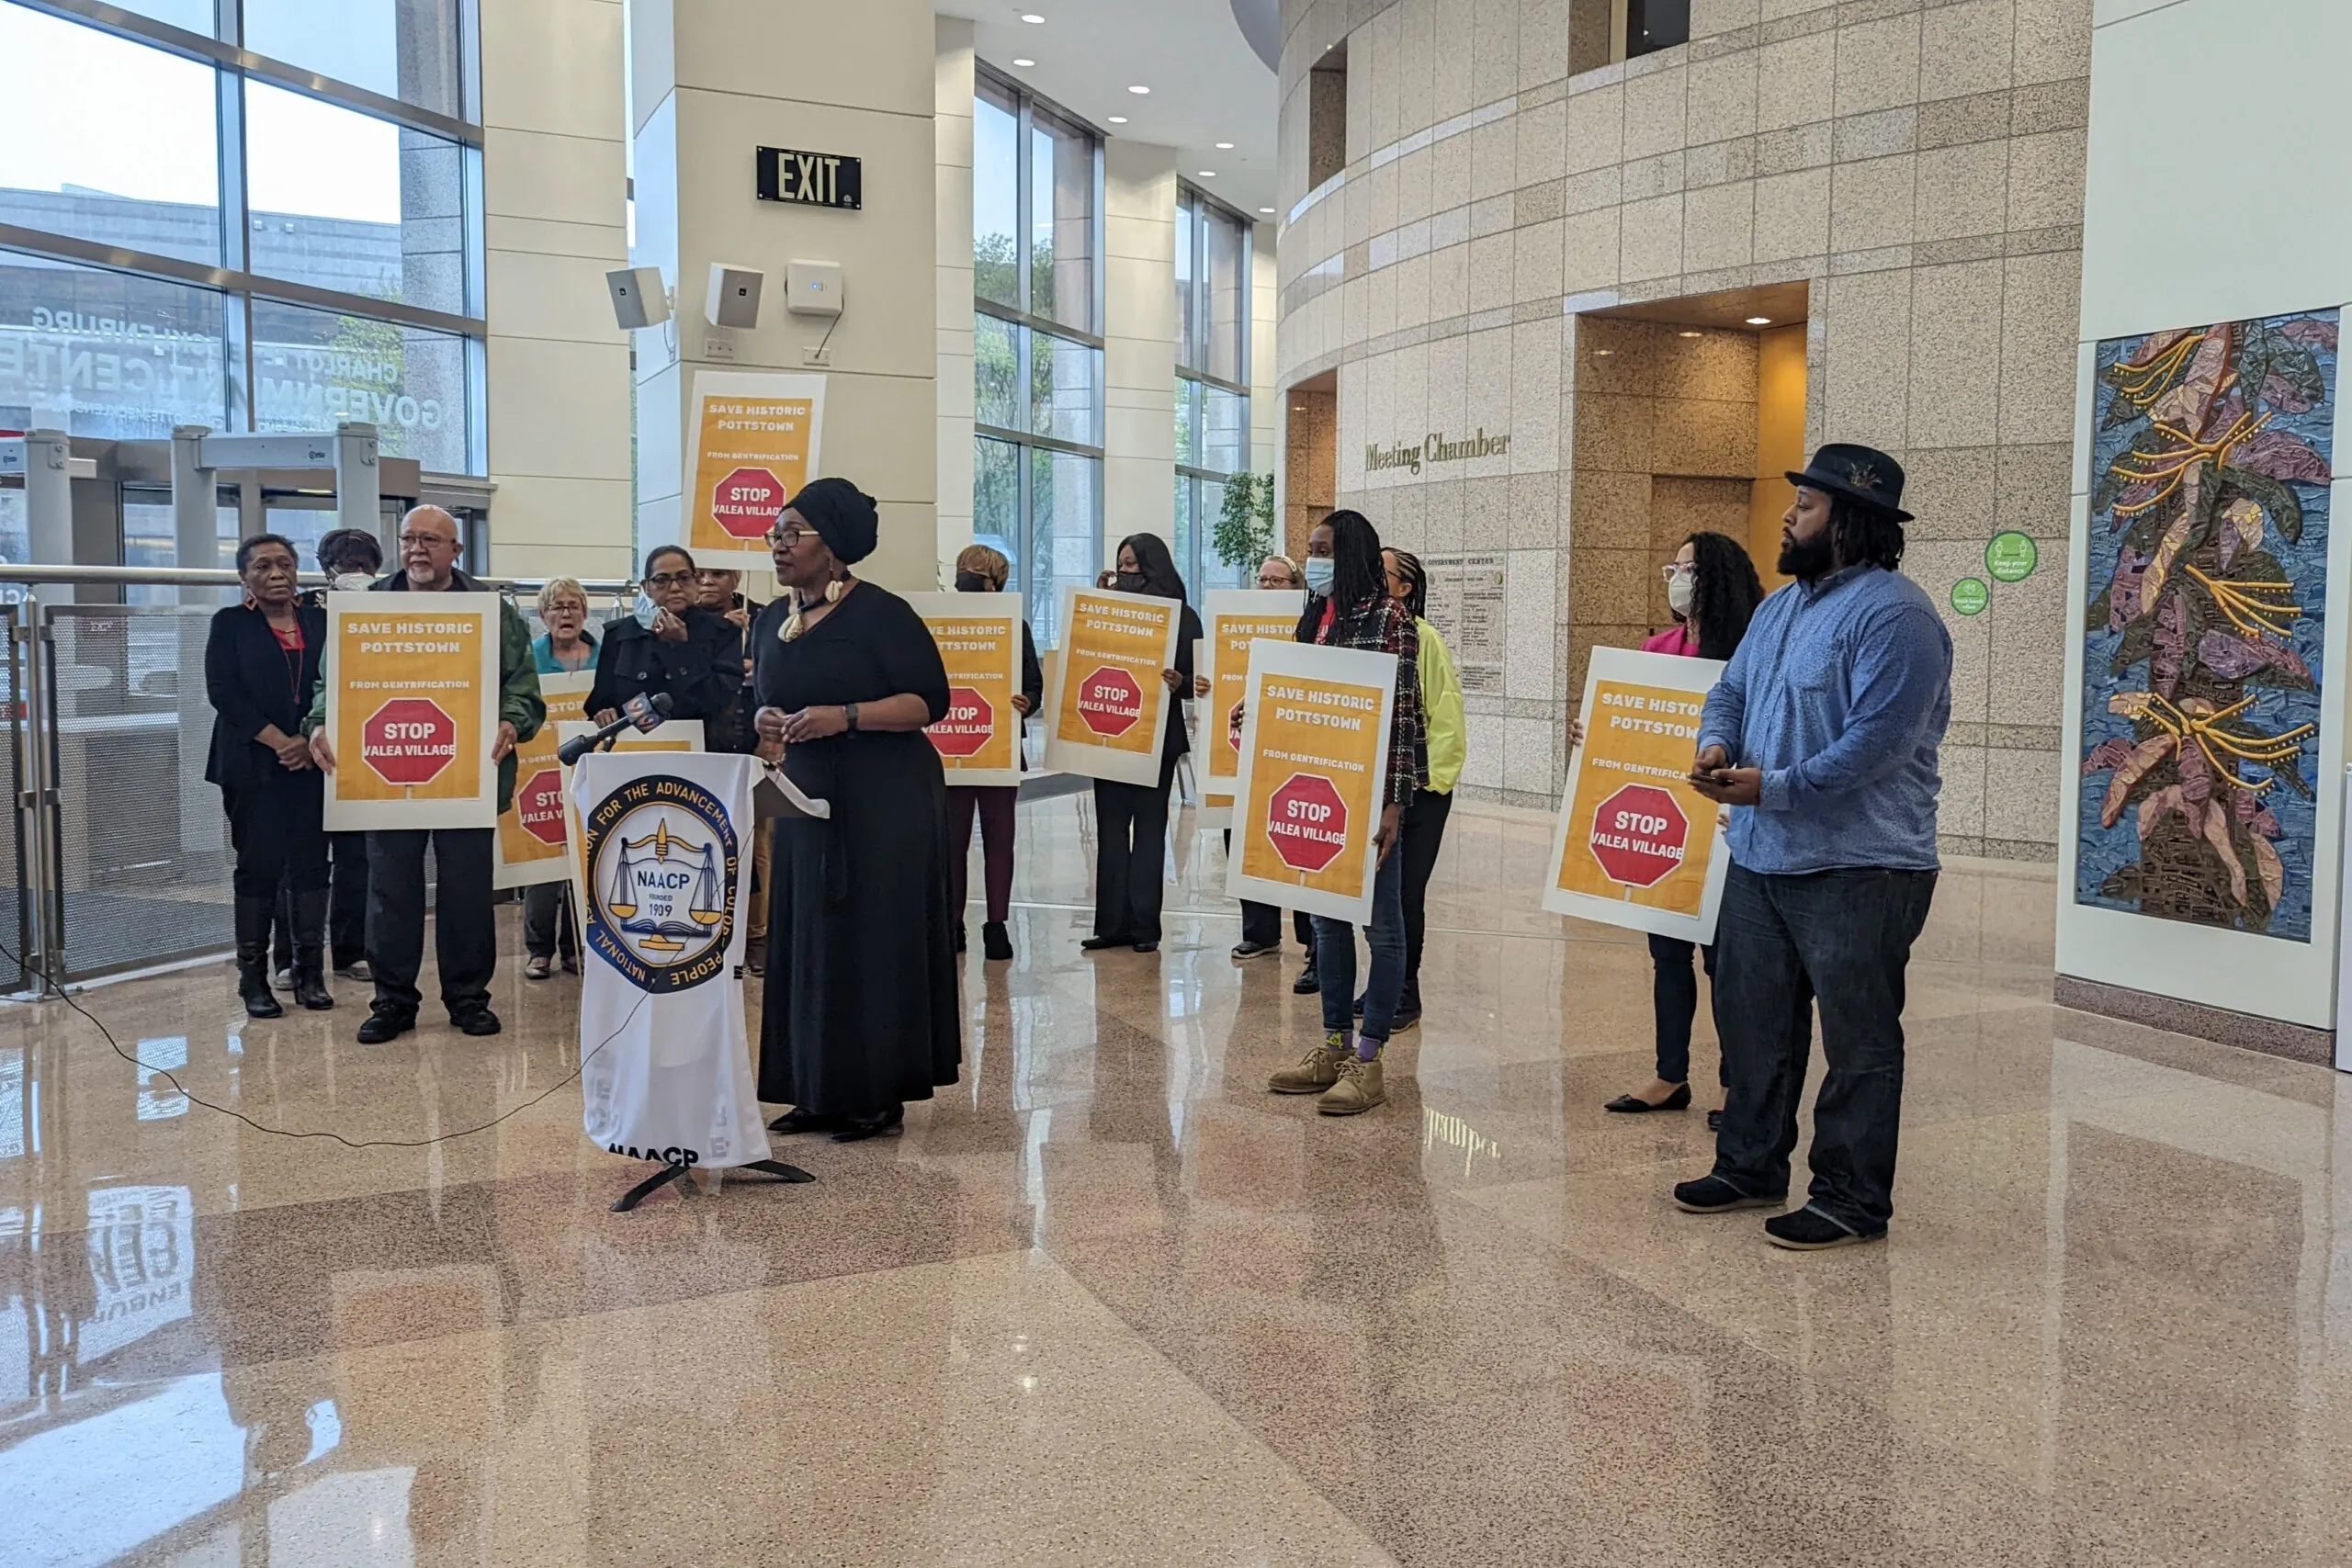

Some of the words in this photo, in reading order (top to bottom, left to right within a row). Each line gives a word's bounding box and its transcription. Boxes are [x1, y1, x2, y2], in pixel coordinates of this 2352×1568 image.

[778, 152, 841, 204] EXIT
[709, 404, 743, 414] SAVE
[747, 405, 806, 415] HISTORIC
[718, 420, 794, 431] POTTSTOWN
[707, 451, 730, 459] FROM
[732, 453, 798, 461] GENTRIFICATION
[1365, 442, 1421, 475] Meeting
[1424, 427, 1511, 462] Chamber
[730, 487, 771, 502] STOP
[1080, 603, 1108, 615] SAVE
[1112, 606, 1164, 623] HISTORIC
[347, 623, 391, 634] SAVE
[397, 623, 473, 634] HISTORIC
[947, 626, 1006, 635] HISTORIC
[1086, 619, 1153, 637] POTTSTOWN
[1222, 625, 1253, 634] SAVE
[1257, 625, 1296, 634] HISTO
[360, 642, 459, 653] POTTSTOWN
[937, 641, 996, 650] TTSTOWN
[1076, 649, 1095, 658] FROM
[1097, 652, 1156, 666] GENTRIFICATION
[382, 681, 469, 689] GENTRIFICATION
[1094, 685, 1128, 701] STOP
[1267, 685, 1305, 701] SAVE
[1308, 691, 1374, 711] HISTORIC
[1601, 692, 1645, 709] SAVE
[1648, 698, 1702, 717] HISTO
[1106, 705, 1139, 716] VILLAGE
[1276, 707, 1362, 731] POTTSTOWN
[384, 723, 435, 739] STOP
[955, 725, 992, 734] VILLAGE
[1610, 715, 1700, 739] POTTSTOW
[405, 744, 456, 756] VILLAGE
[1262, 749, 1287, 760] FROM
[1290, 753, 1364, 773] GENTRIFICATION
[1592, 757, 1622, 770] FROM
[1623, 762, 1691, 781] GENTRIFICA
[624, 782, 650, 803] THE
[596, 799, 623, 826] FOR
[656, 782, 733, 848] ADVANCEMENT
[1287, 799, 1331, 823] STOP
[1614, 810, 1668, 836] STOP
[1302, 827, 1345, 845] VILLAGE
[1632, 838, 1684, 861] VILLAGE
[726, 856, 737, 875] OF
[637, 871, 690, 890] NAACP
[649, 893, 673, 902] FOUNDED
[649, 903, 673, 917] 1909
[721, 886, 736, 948] COLOR
[595, 929, 646, 982] NATIONAL
[670, 951, 723, 986] PEOPLE
